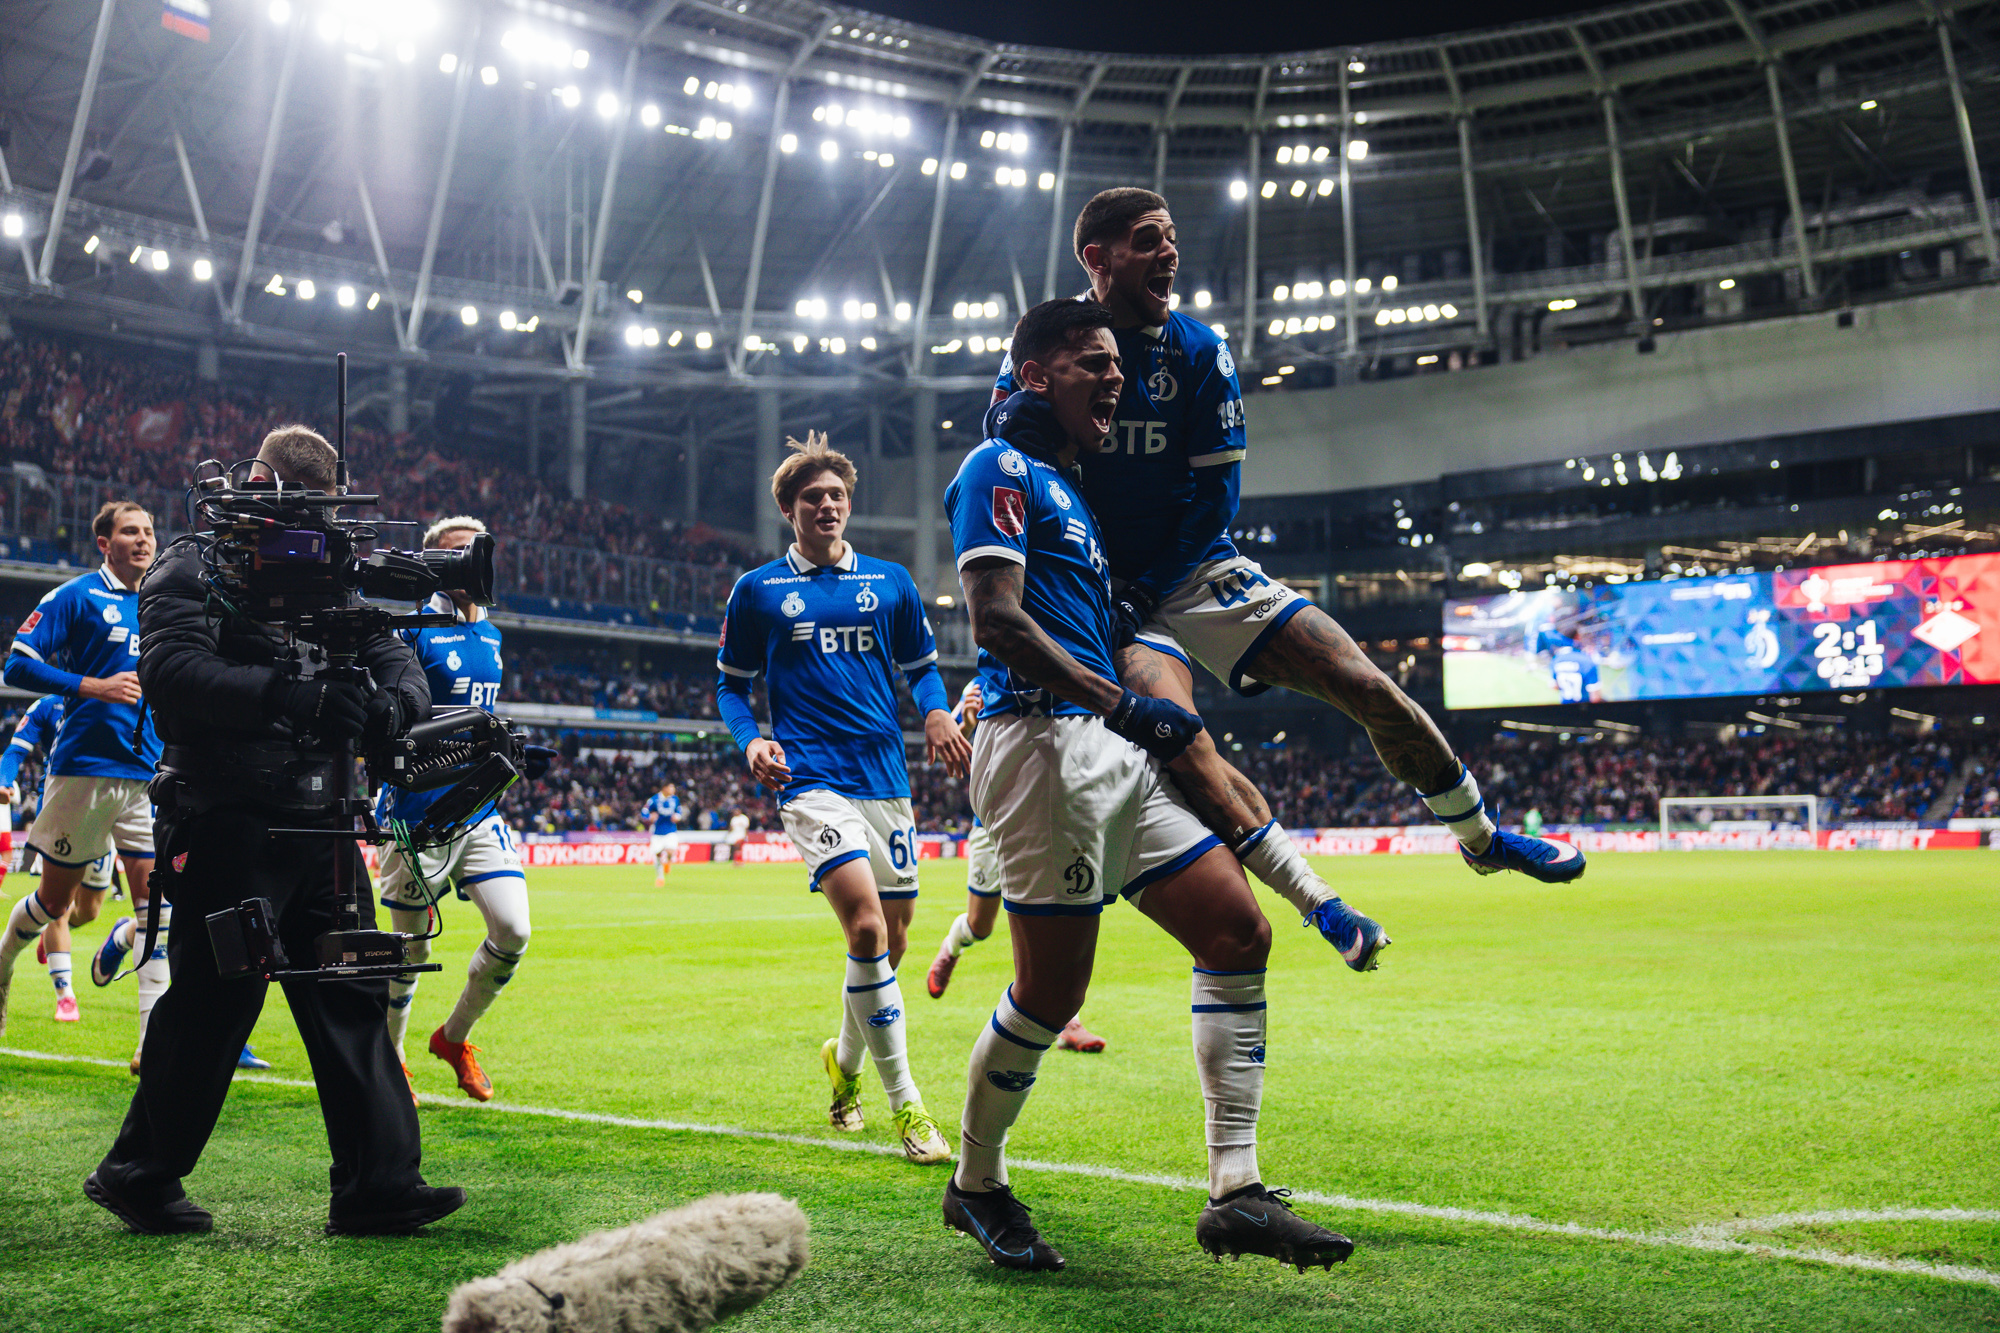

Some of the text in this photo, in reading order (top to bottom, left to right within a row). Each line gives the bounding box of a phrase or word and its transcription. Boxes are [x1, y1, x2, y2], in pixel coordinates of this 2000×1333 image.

[390, 572, 418, 582] FUJINON
[762, 575, 811, 586] wildberries
[838, 573, 885, 581] CHANGAN
[1207, 567, 1271, 609] 44
[1253, 589, 1288, 619] BOSCO
[819, 625, 874, 654] ВТБ
[1812, 619, 1885, 659] 2:1
[533, 843, 624, 866] БУКМЕКЕР
[889, 826, 918, 870] 60
